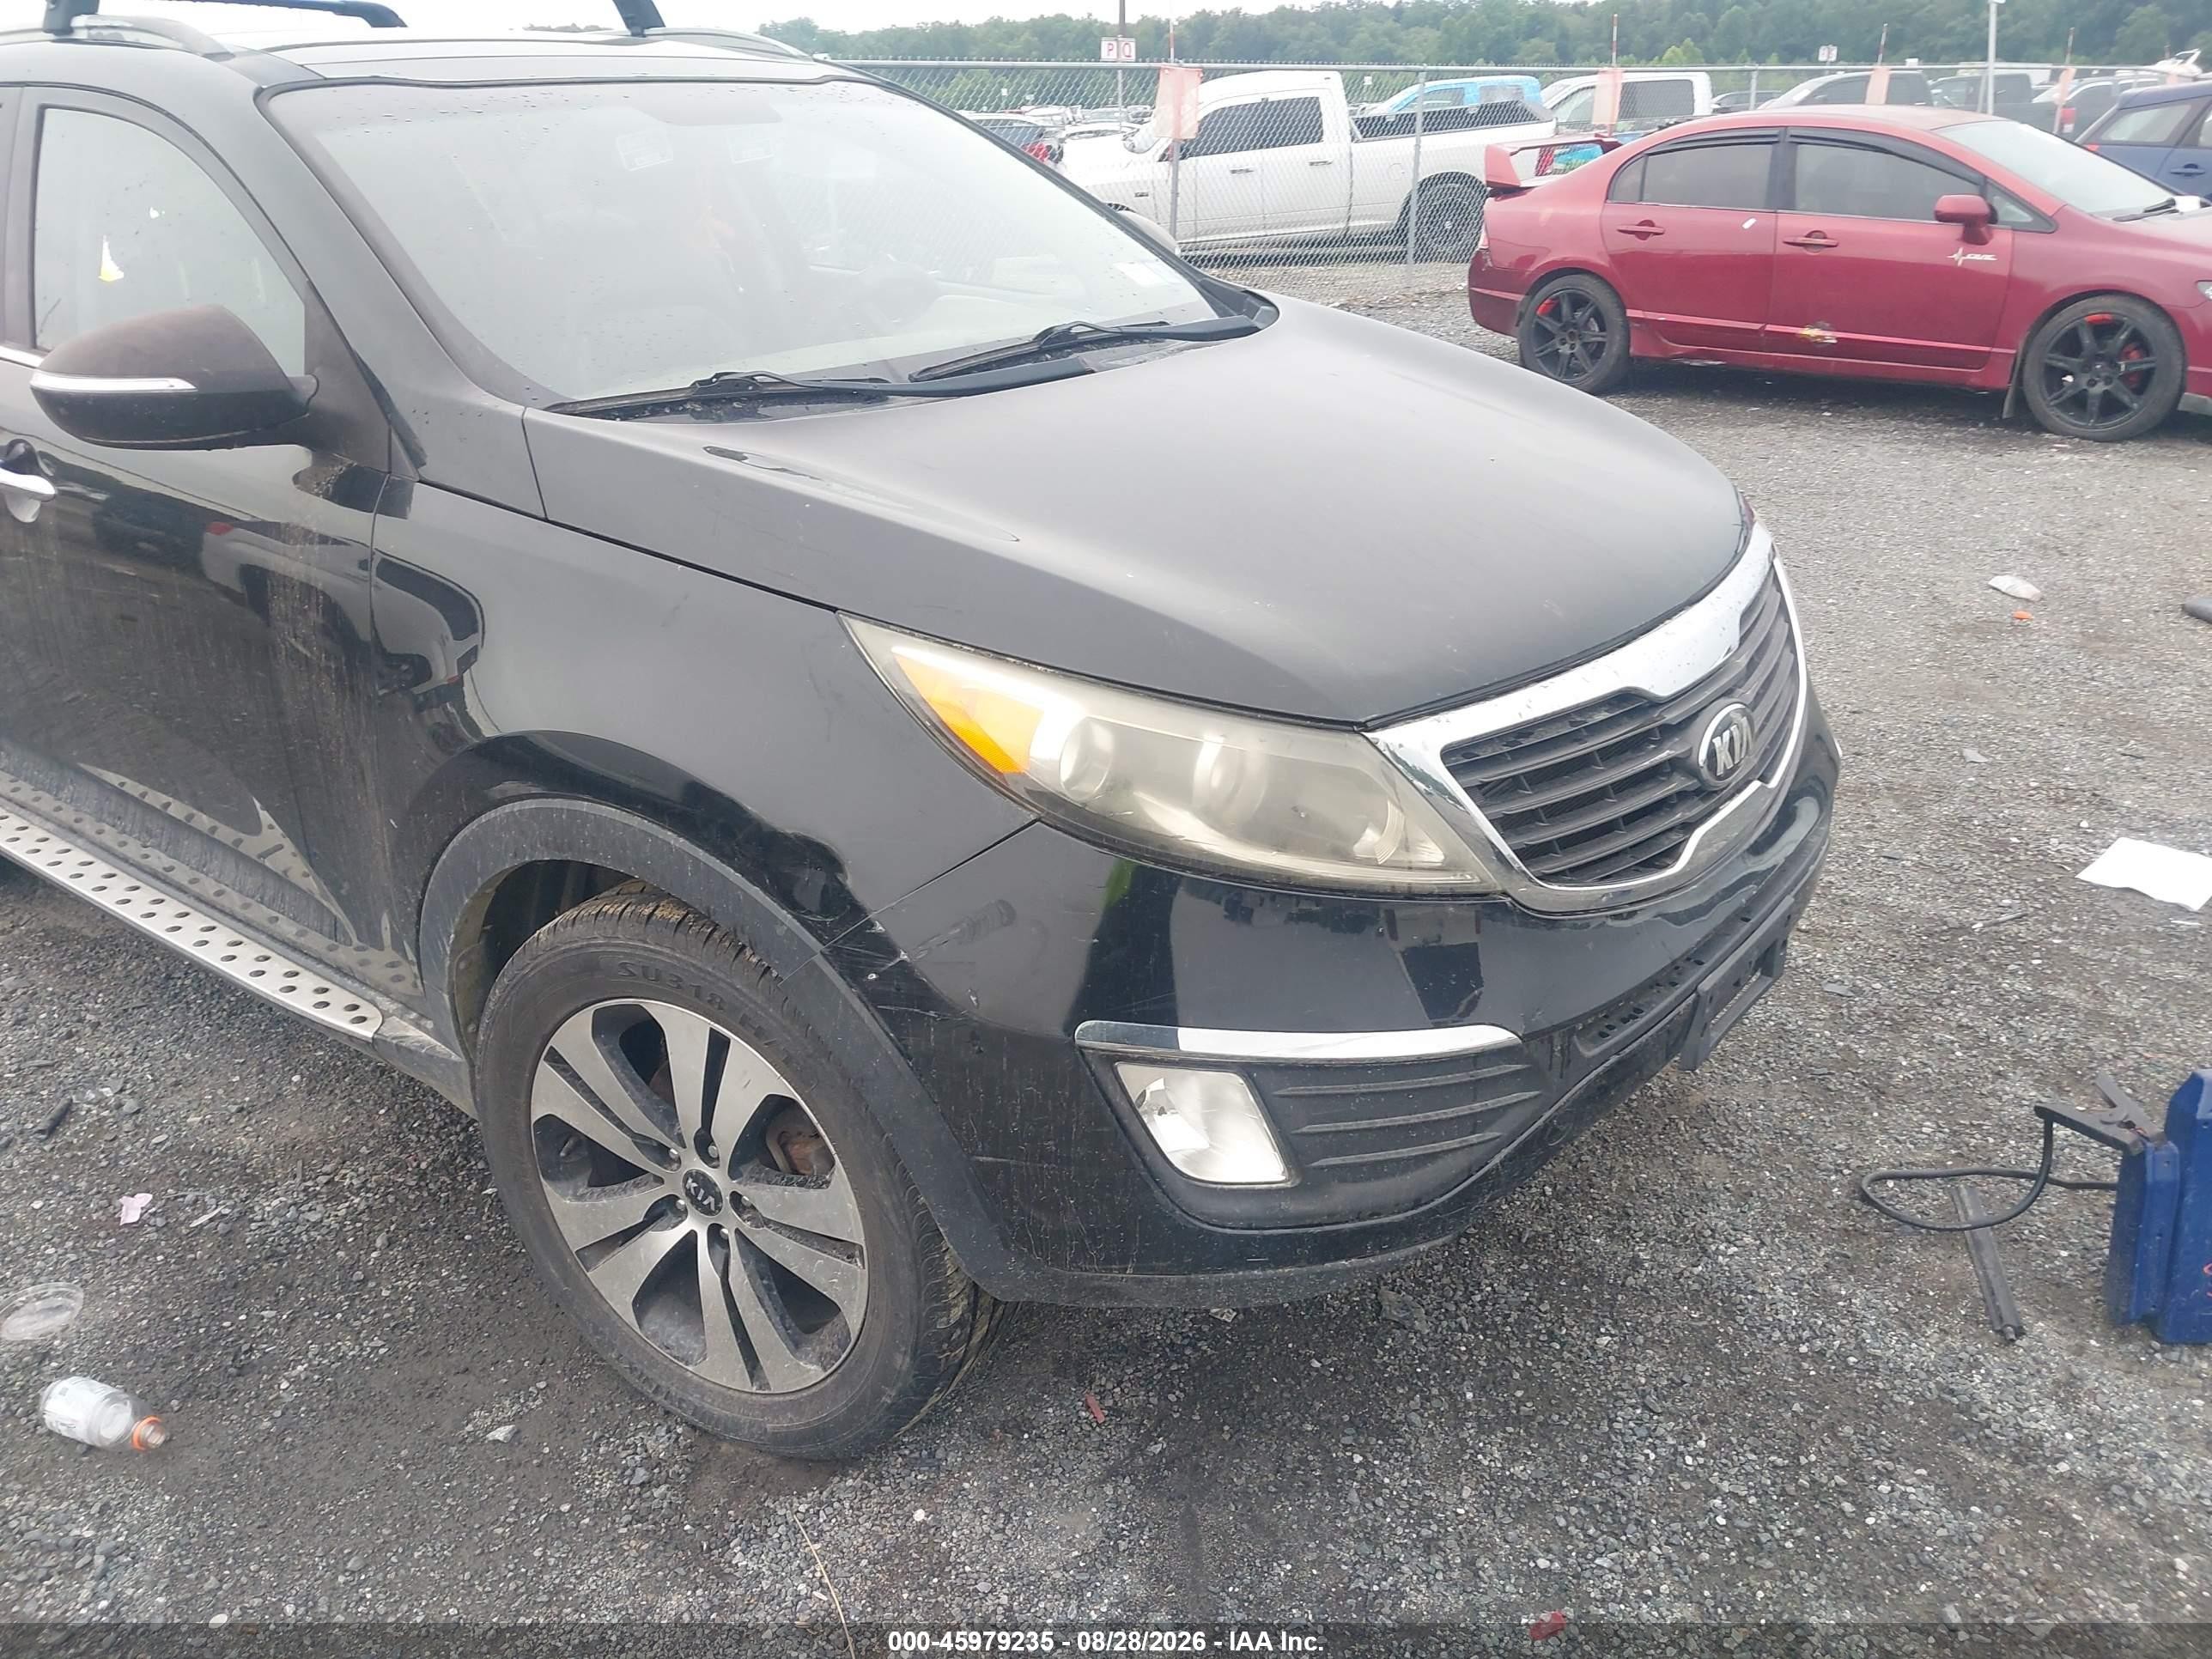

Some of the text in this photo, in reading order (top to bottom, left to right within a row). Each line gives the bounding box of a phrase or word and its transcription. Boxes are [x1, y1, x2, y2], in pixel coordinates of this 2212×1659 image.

[1108, 43, 1114, 57] P
[1122, 42, 1132, 58] Q
[1711, 716, 1753, 777] KIA
[617, 961, 725, 1011] SU318
[685, 1176, 715, 1212] KIA
